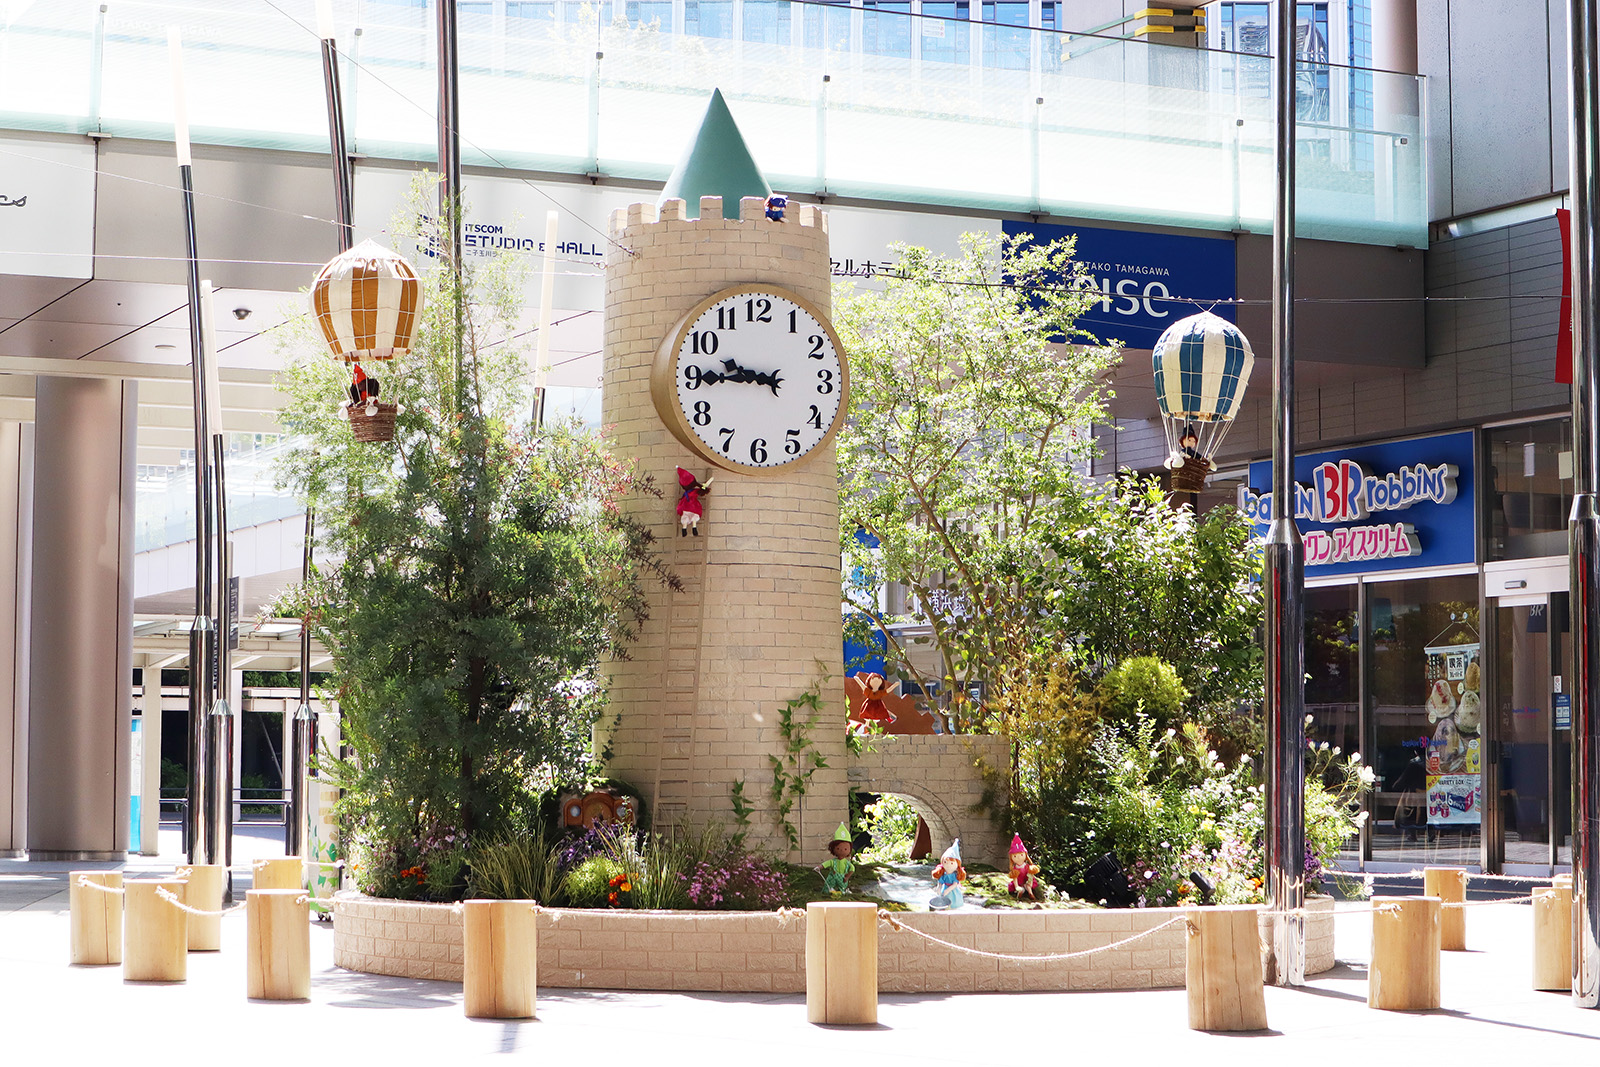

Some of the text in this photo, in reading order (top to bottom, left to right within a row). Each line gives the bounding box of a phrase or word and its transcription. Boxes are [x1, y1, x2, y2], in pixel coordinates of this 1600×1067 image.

[464, 234, 534, 252] STUDIO
[555, 241, 603, 256] HALL
[1072, 260, 1170, 276] FTAKO TAMAGAWA
[716, 306, 737, 331] 11
[744, 298, 772, 323] 12
[787, 309, 798, 334] 1
[690, 330, 719, 355] 10
[808, 334, 825, 360] 2
[684, 364, 702, 390] 9
[816, 369, 833, 394] 3
[693, 400, 712, 426] 8
[806, 404, 824, 429] 4
[719, 427, 736, 453] 7
[750, 438, 768, 463] 6
[784, 429, 801, 455] 5
[1315, 460, 1363, 520] BR
[1335, 527, 1410, 558] アイスクリーム
